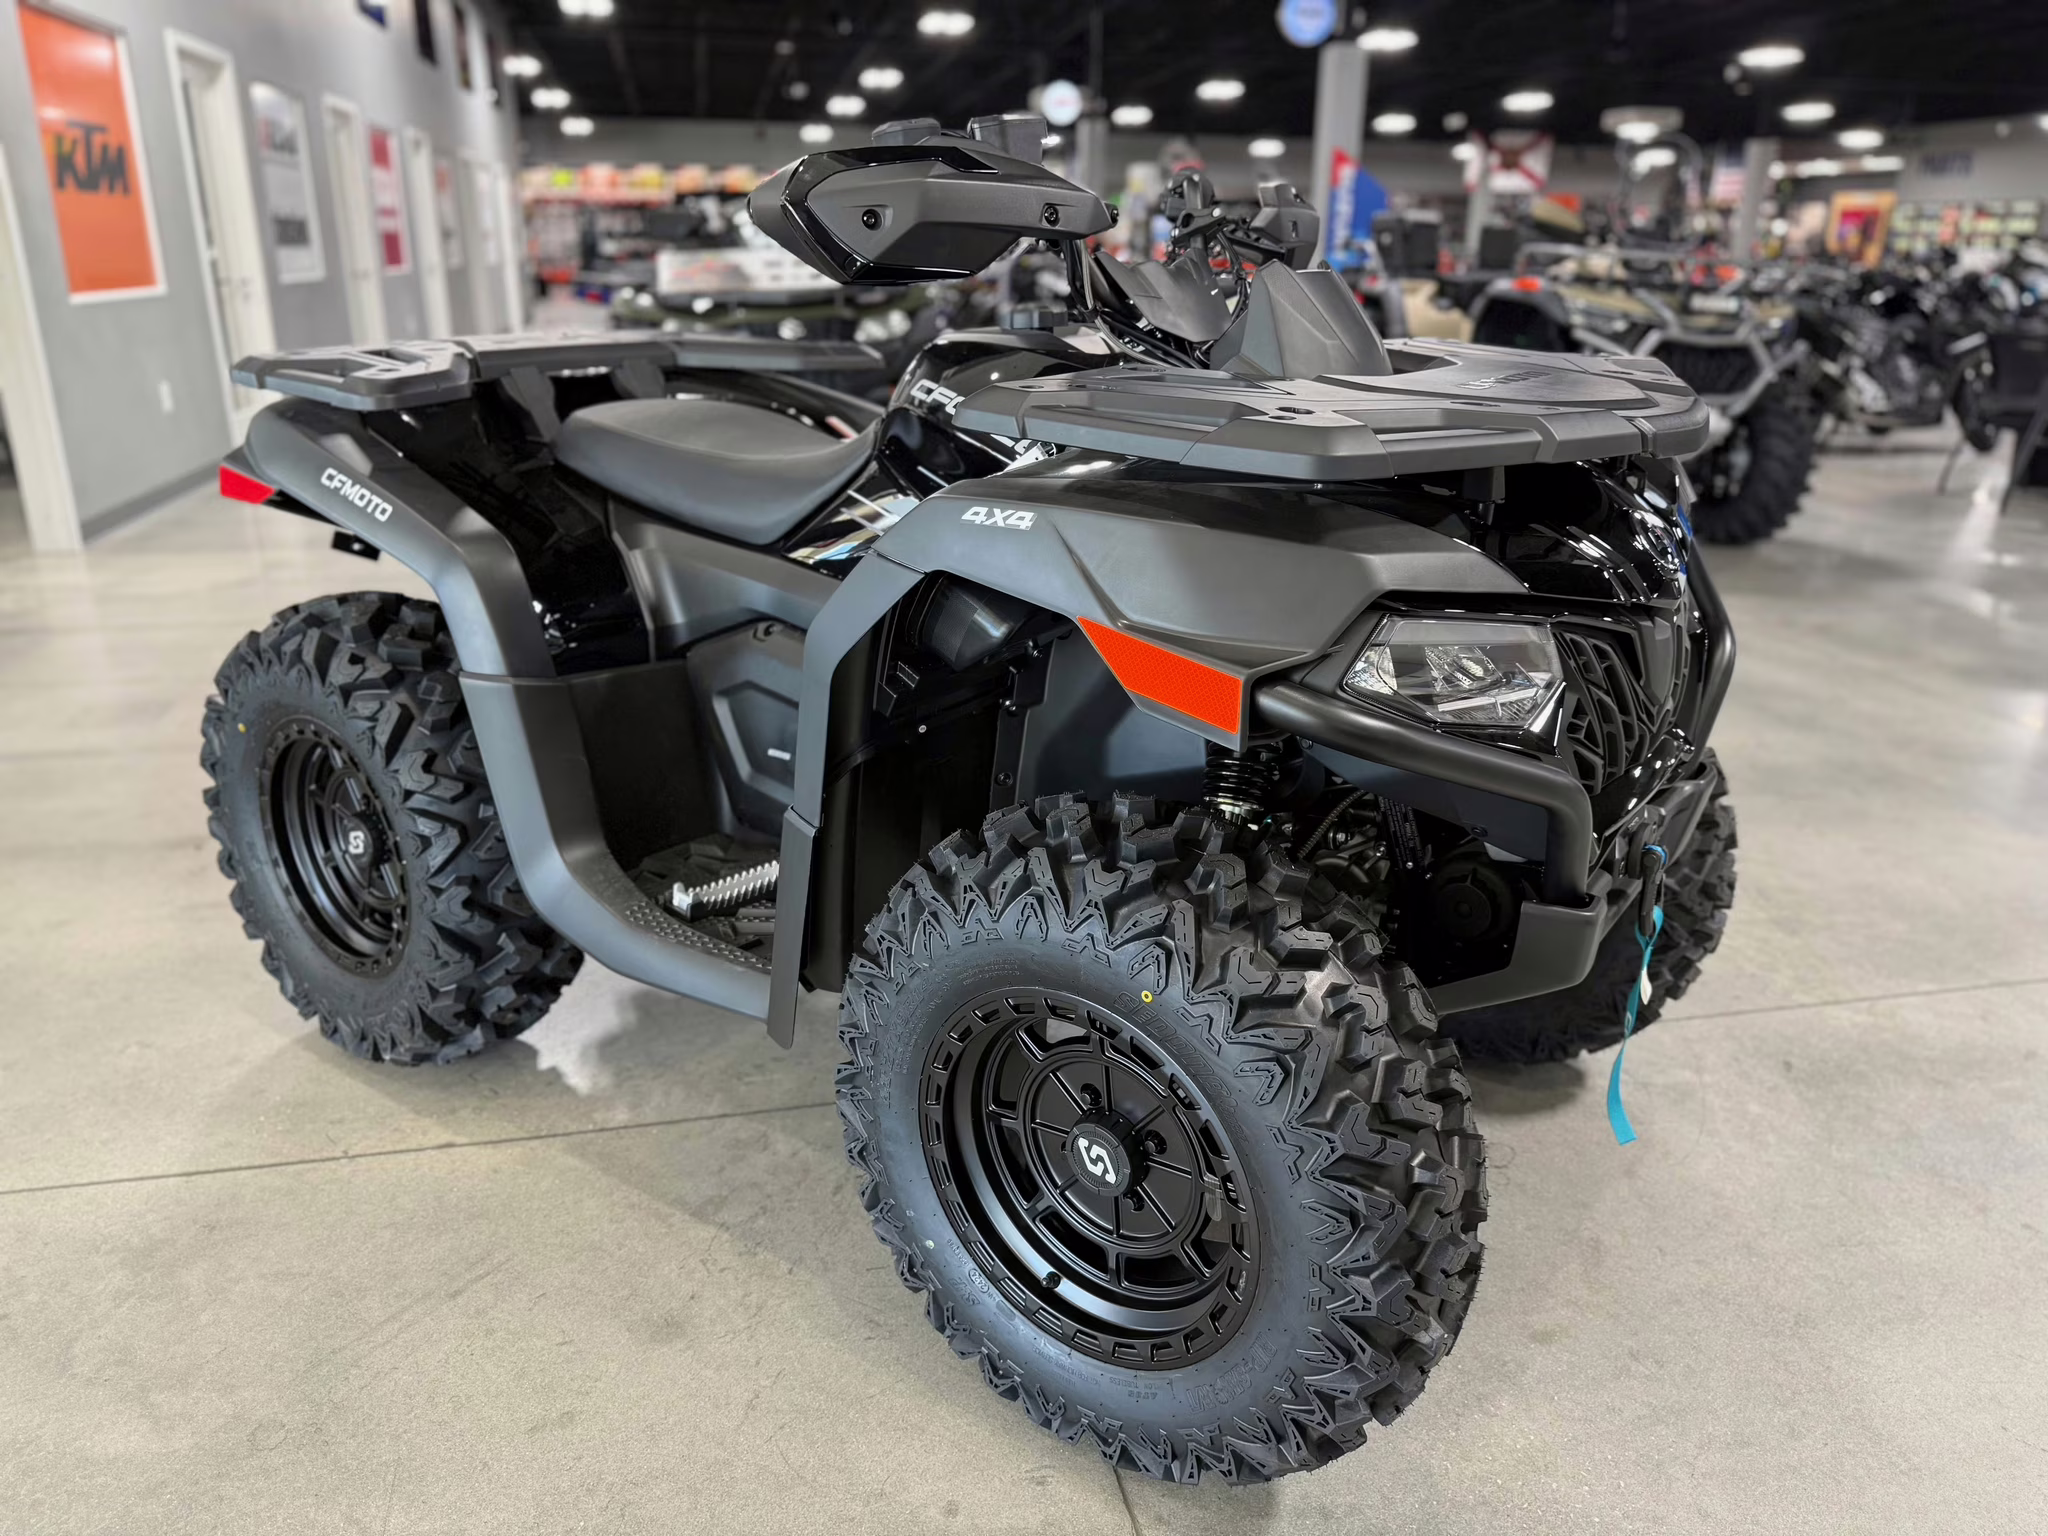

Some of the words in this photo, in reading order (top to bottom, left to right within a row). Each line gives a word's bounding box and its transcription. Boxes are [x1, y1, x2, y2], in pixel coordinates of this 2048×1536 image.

[56, 121, 131, 196] KTM
[320, 467, 393, 522] CFMOTO
[960, 506, 1035, 530] 4X4
[1112, 992, 1232, 1099] SEDONA
